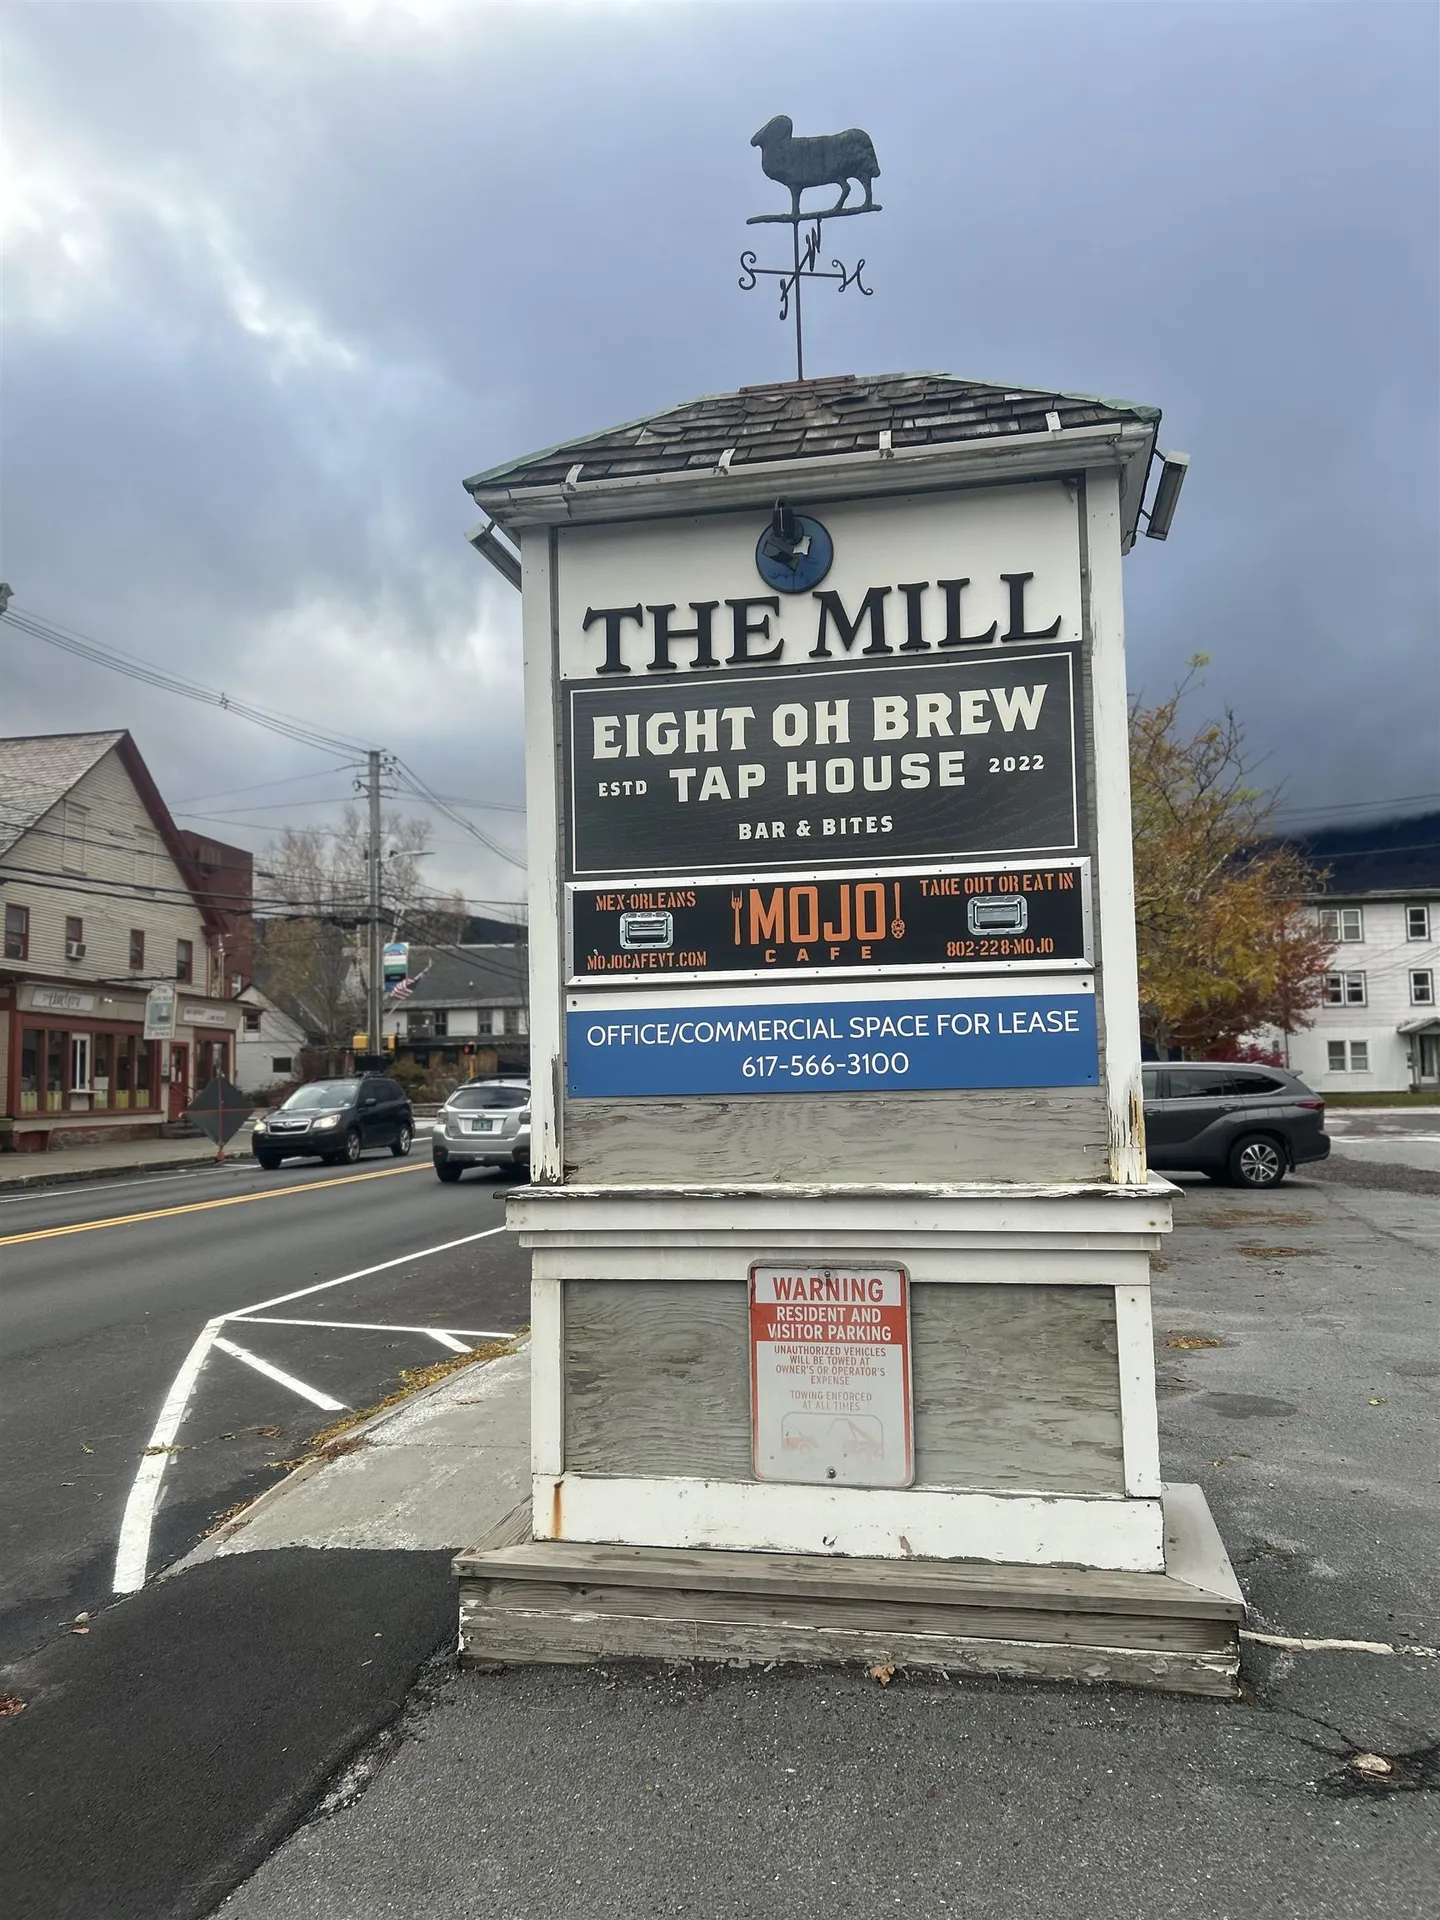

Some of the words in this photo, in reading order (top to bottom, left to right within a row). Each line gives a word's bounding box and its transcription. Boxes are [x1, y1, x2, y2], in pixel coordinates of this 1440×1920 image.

[582, 596, 785, 675] THE
[808, 571, 1062, 658] MILL
[592, 706, 756, 760] EIGHT
[772, 699, 851, 748] OH
[872, 683, 1049, 742] BREW
[598, 780, 648, 797] ESTD
[669, 763, 766, 803] TAP
[787, 750, 966, 797] HOUSE
[988, 754, 1045, 773] 2022
[738, 821, 786, 840] BAR
[796, 820, 811, 837] &
[822, 815, 893, 836] BITES
[919, 878, 961, 897] TAKE
[963, 876, 994, 895] OUT
[999, 875, 1019, 893] OR
[1022, 873, 1055, 892] EAT
[1058, 872, 1074, 890] IN
[749, 882, 887, 945] MOJO
[586, 950, 707, 970] MOJOCAFEVT.COM
[765, 945, 872, 963] CAFE
[587, 1018, 843, 1047] OFFICE/COMMERCIAL
[849, 1014, 930, 1039] SPACE
[937, 1012, 990, 1036] FOR
[998, 1010, 1080, 1034] LEASE
[742, 1052, 909, 1077] 617-566-3100
[772, 1277, 884, 1303] WARNING
[776, 1306, 846, 1322] RESIDENT
[851, 1308, 881, 1323] AND
[767, 1323, 823, 1339] VISITOR
[829, 1325, 891, 1341] PARKING
[774, 1345, 841, 1356] UNAUTHORIZED
[843, 1347, 886, 1357] VEHICLES
[789, 1355, 810, 1365] WILL
[813, 1356, 824, 1366] BE
[827, 1356, 857, 1366] TOWED
[859, 1357, 870, 1367] AT
[775, 1364, 815, 1375] OWNER'S
[816, 1366, 829, 1375] OR
[831, 1366, 886, 1377] OPERATOR'S
[810, 1375, 850, 1385] EXPENSE
[790, 1390, 824, 1400] TOWING
[826, 1391, 872, 1402] ENFORCED
[802, 1400, 813, 1410] AT
[815, 1401, 831, 1411] ALL
[834, 1401, 860, 1411] TIMES
